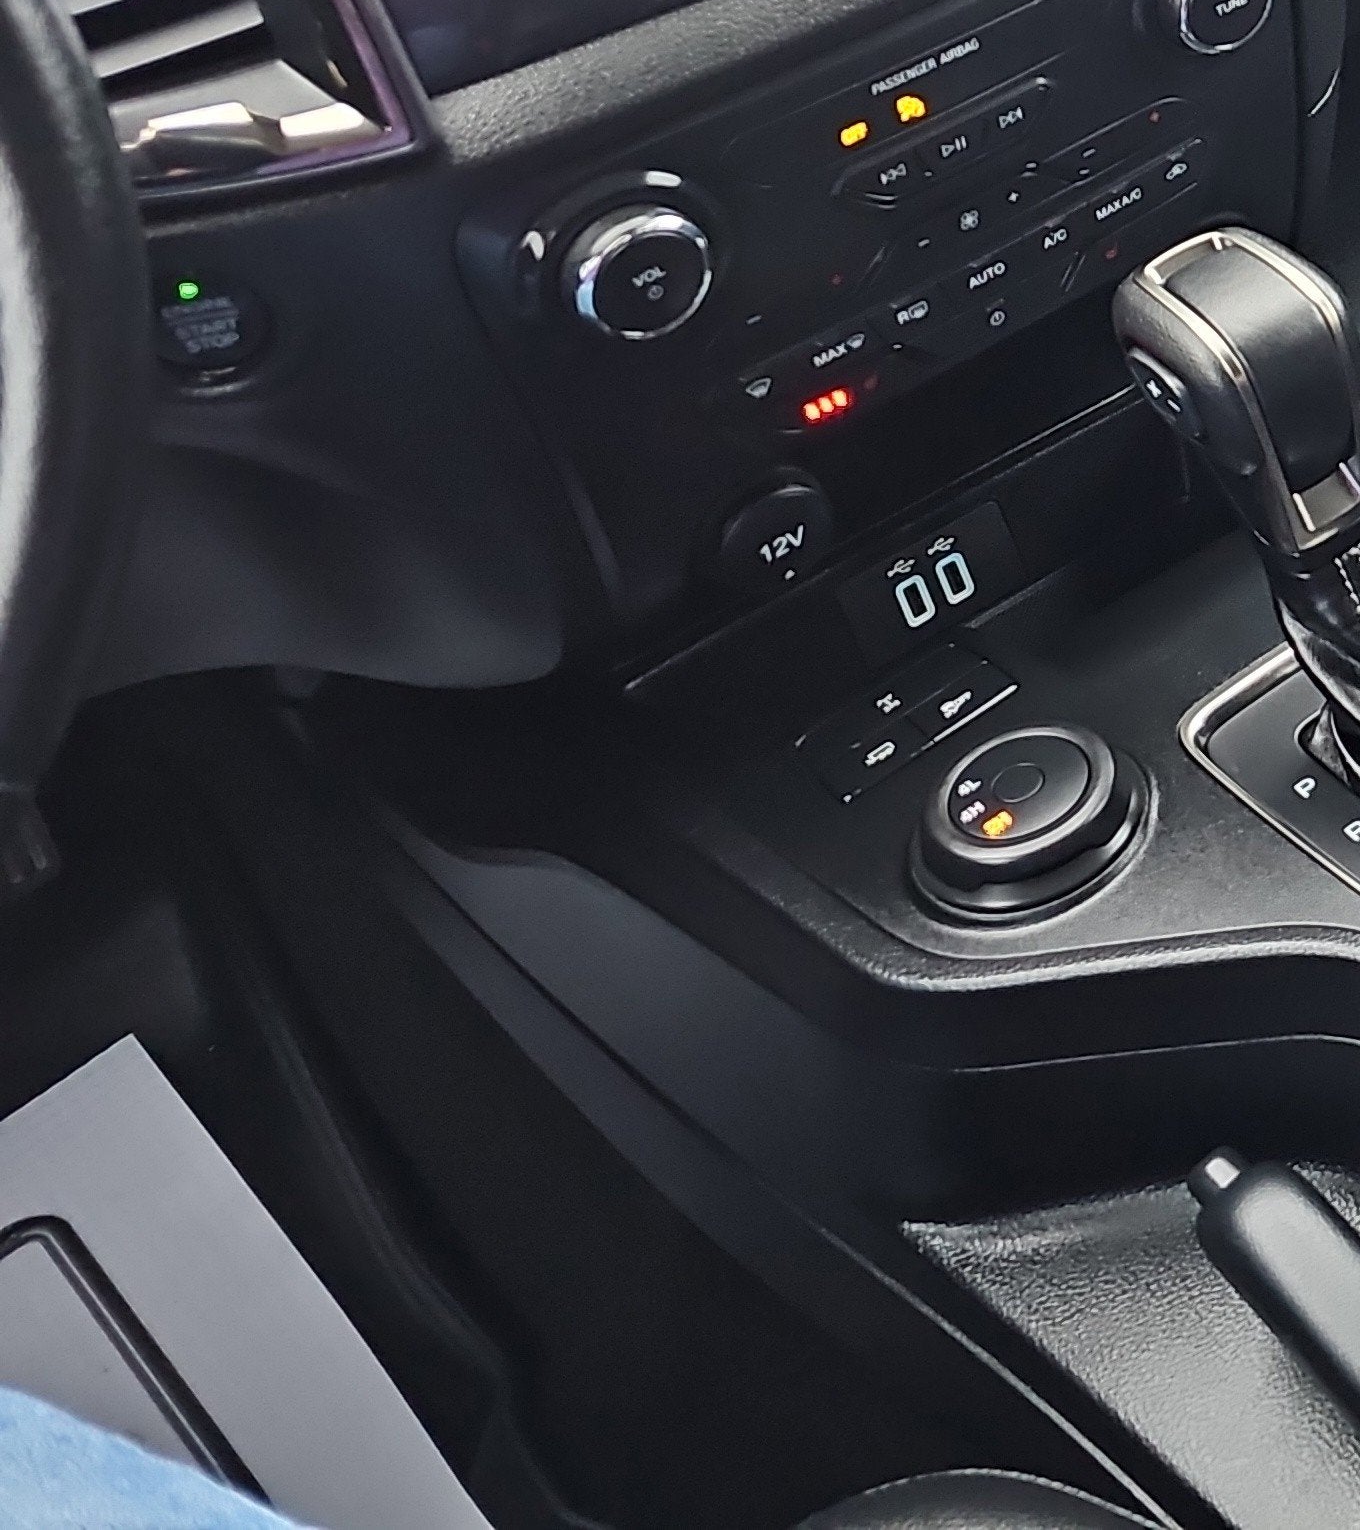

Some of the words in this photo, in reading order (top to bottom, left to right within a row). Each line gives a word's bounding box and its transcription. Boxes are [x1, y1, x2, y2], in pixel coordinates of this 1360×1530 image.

[871, 57, 938, 95] PASSENGER
[939, 37, 980, 65] AIRBAG
[1095, 199, 1123, 221] MAX
[1043, 228, 1068, 250] A/C
[632, 266, 667, 287] VOL
[968, 262, 1006, 290] AUTO
[812, 342, 848, 368] MAX
[760, 524, 804, 563] 12V
[1293, 777, 1316, 799] P
